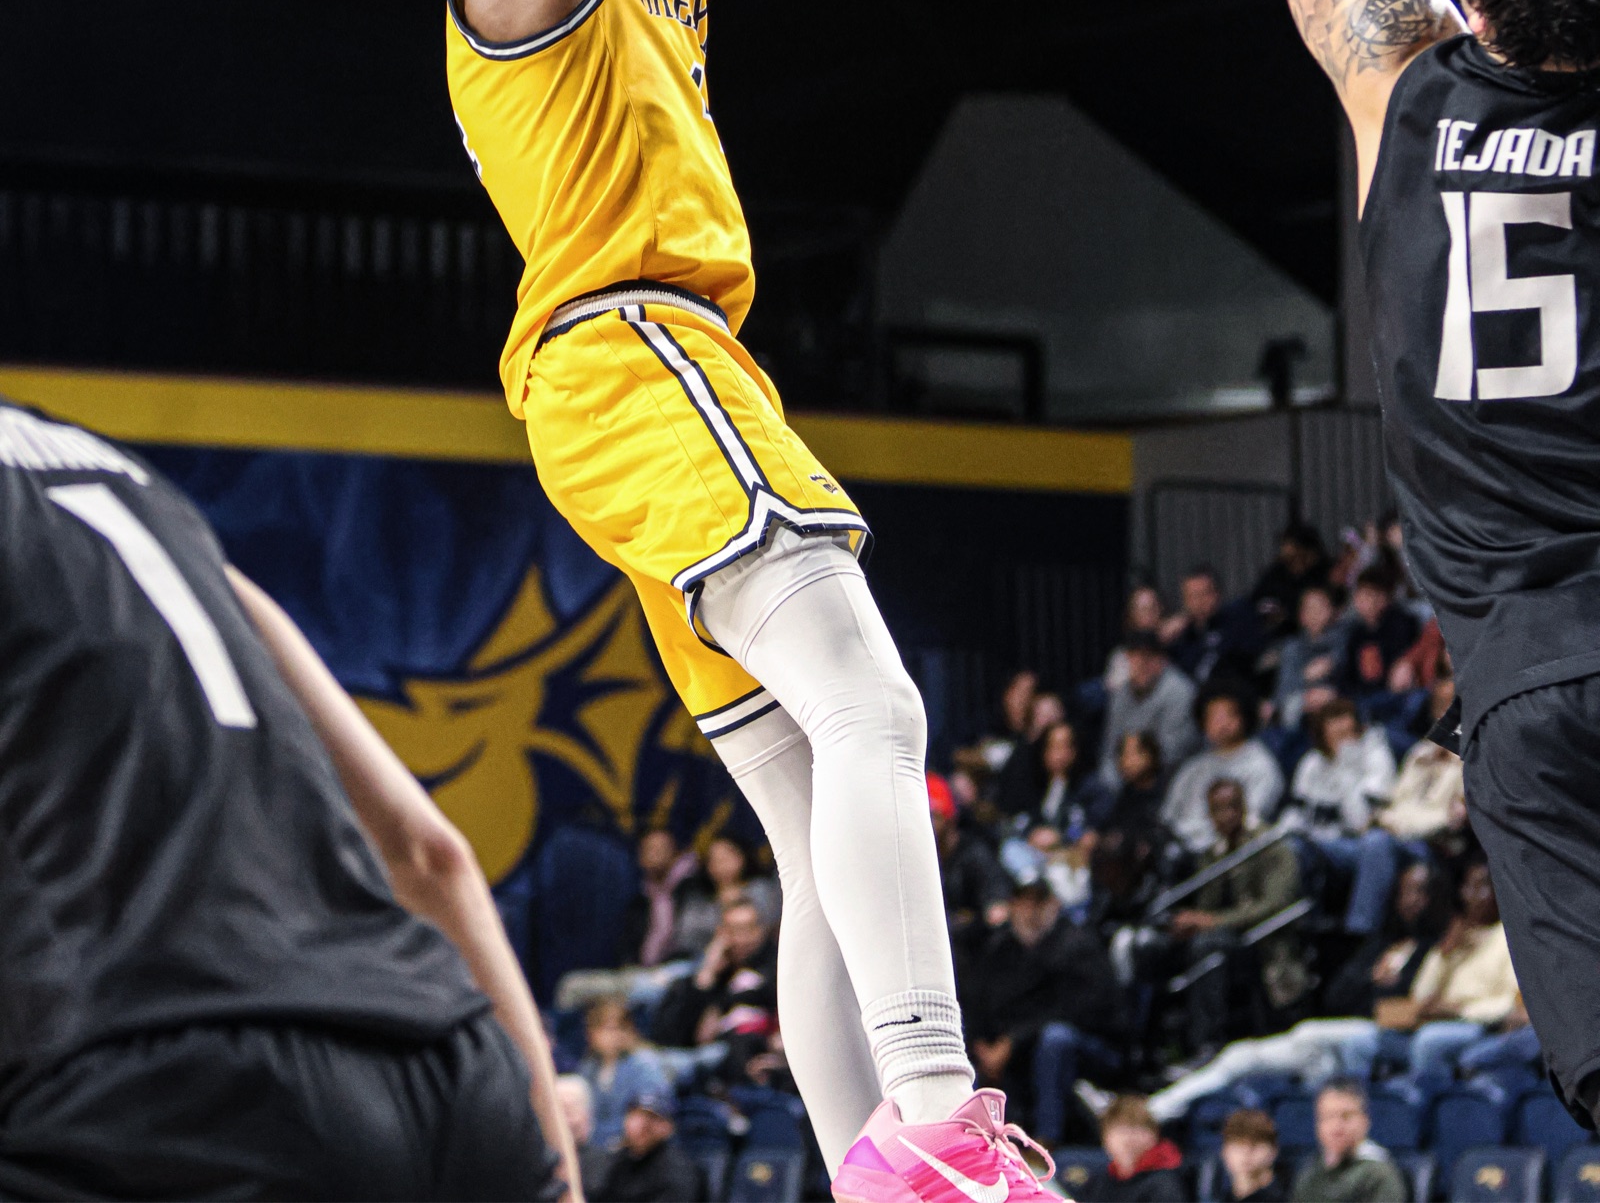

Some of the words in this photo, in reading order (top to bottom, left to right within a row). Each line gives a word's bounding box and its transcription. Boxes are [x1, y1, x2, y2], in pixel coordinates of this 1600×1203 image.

[1434, 118, 1597, 178] TEJADA
[1432, 191, 1578, 401] 15
[45, 482, 258, 729] 1
